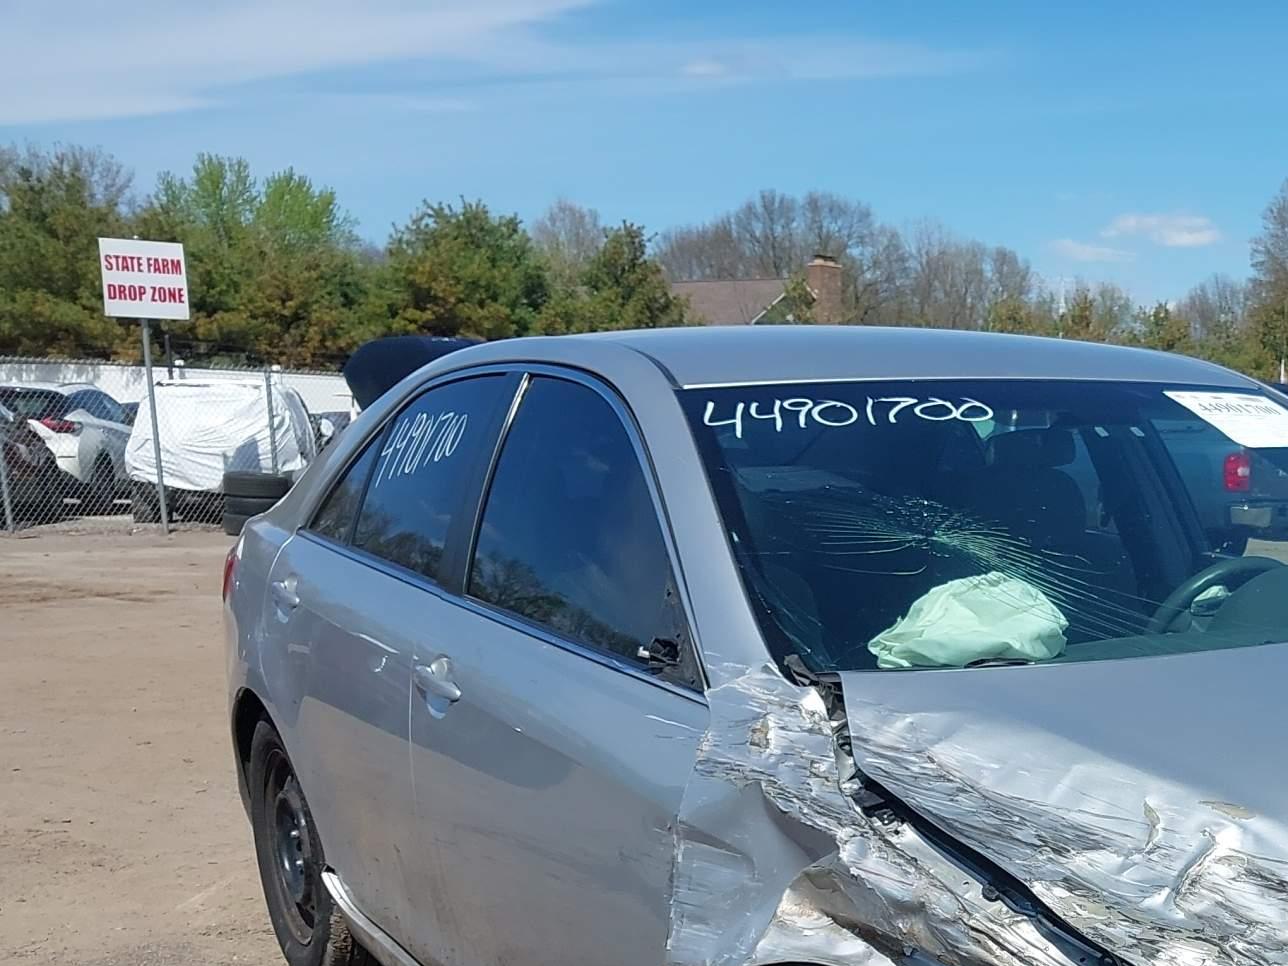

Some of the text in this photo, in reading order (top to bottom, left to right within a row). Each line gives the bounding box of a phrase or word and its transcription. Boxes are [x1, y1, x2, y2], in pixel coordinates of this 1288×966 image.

[104, 254, 182, 275] STATE FARM
[107, 284, 185, 304] DROP ZONE
[703, 396, 994, 438] 44901700
